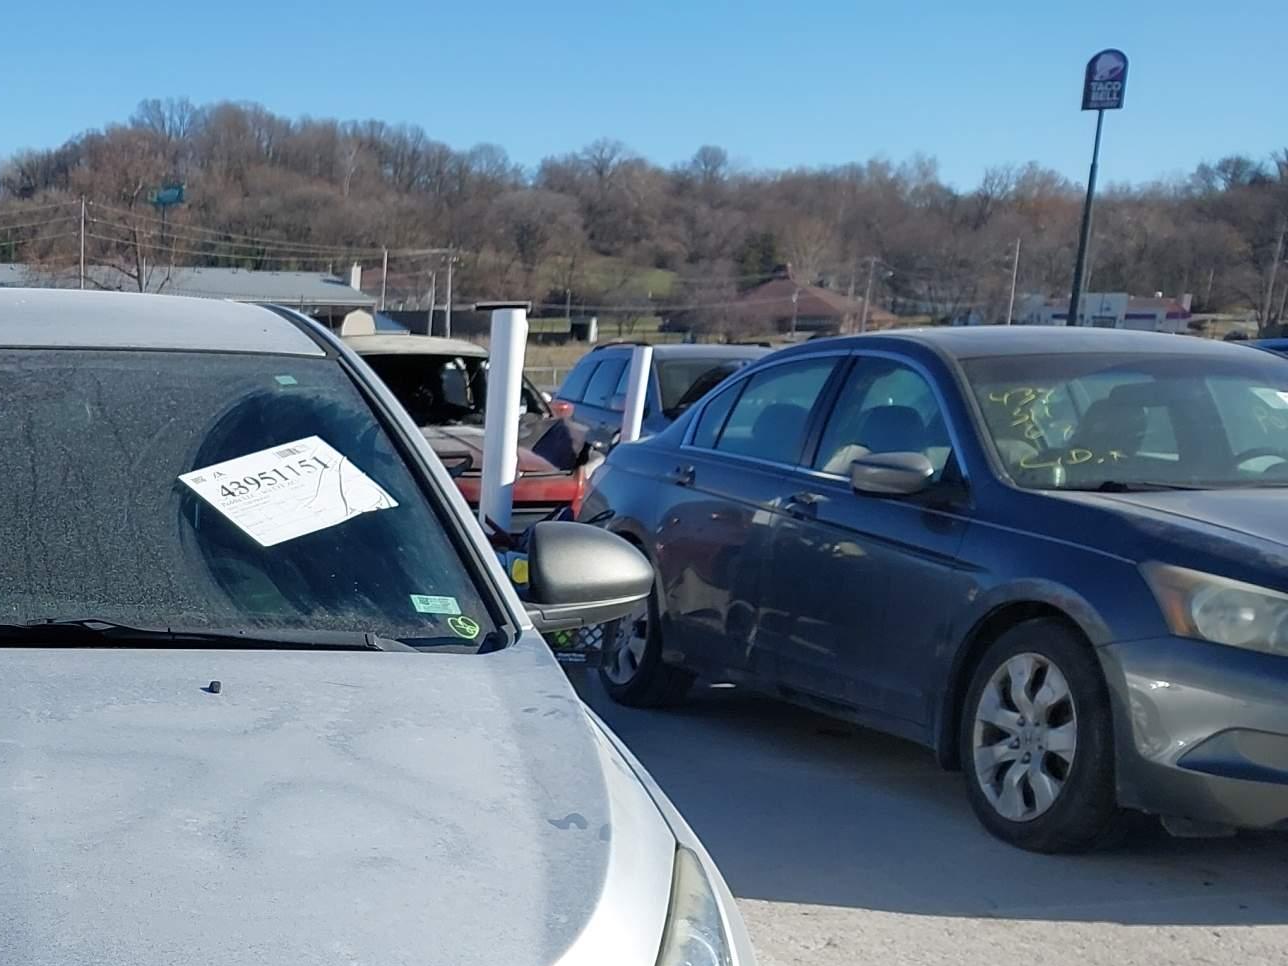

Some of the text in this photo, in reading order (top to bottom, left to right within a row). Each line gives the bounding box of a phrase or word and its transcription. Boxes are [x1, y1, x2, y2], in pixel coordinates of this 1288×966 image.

[1091, 81, 1121, 91] TACO
[1091, 91, 1120, 101] BELL
[220, 456, 330, 499] 43951151
